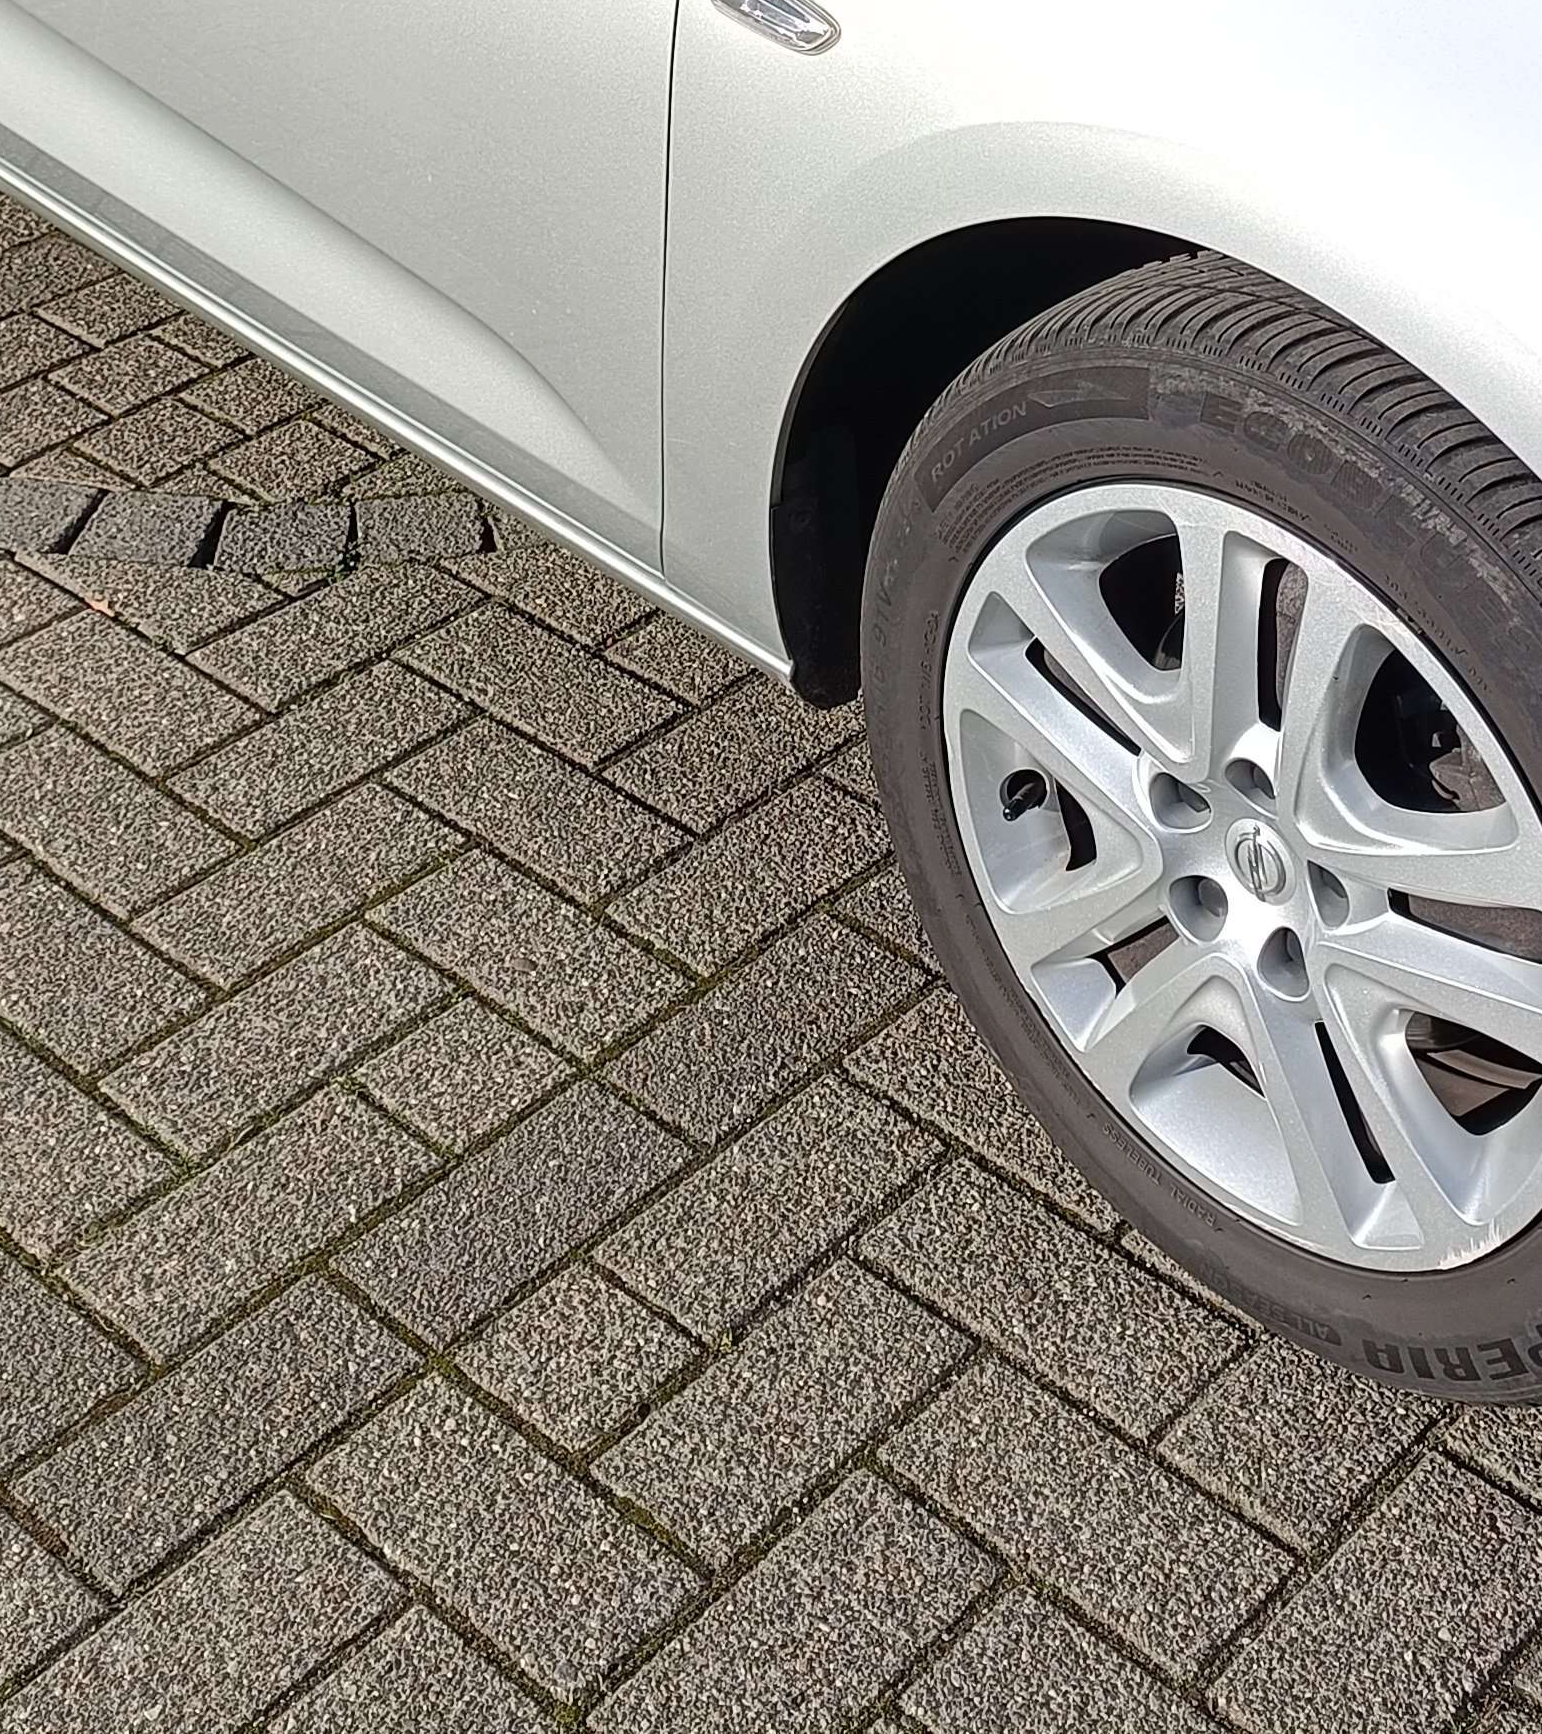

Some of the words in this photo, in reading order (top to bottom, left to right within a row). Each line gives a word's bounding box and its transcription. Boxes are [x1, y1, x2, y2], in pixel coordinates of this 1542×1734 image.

[931, 401, 1027, 484] ROTATION
[1102, 1122, 1162, 1186] TUBELESS
[1170, 1185, 1216, 1227] RADIAL
